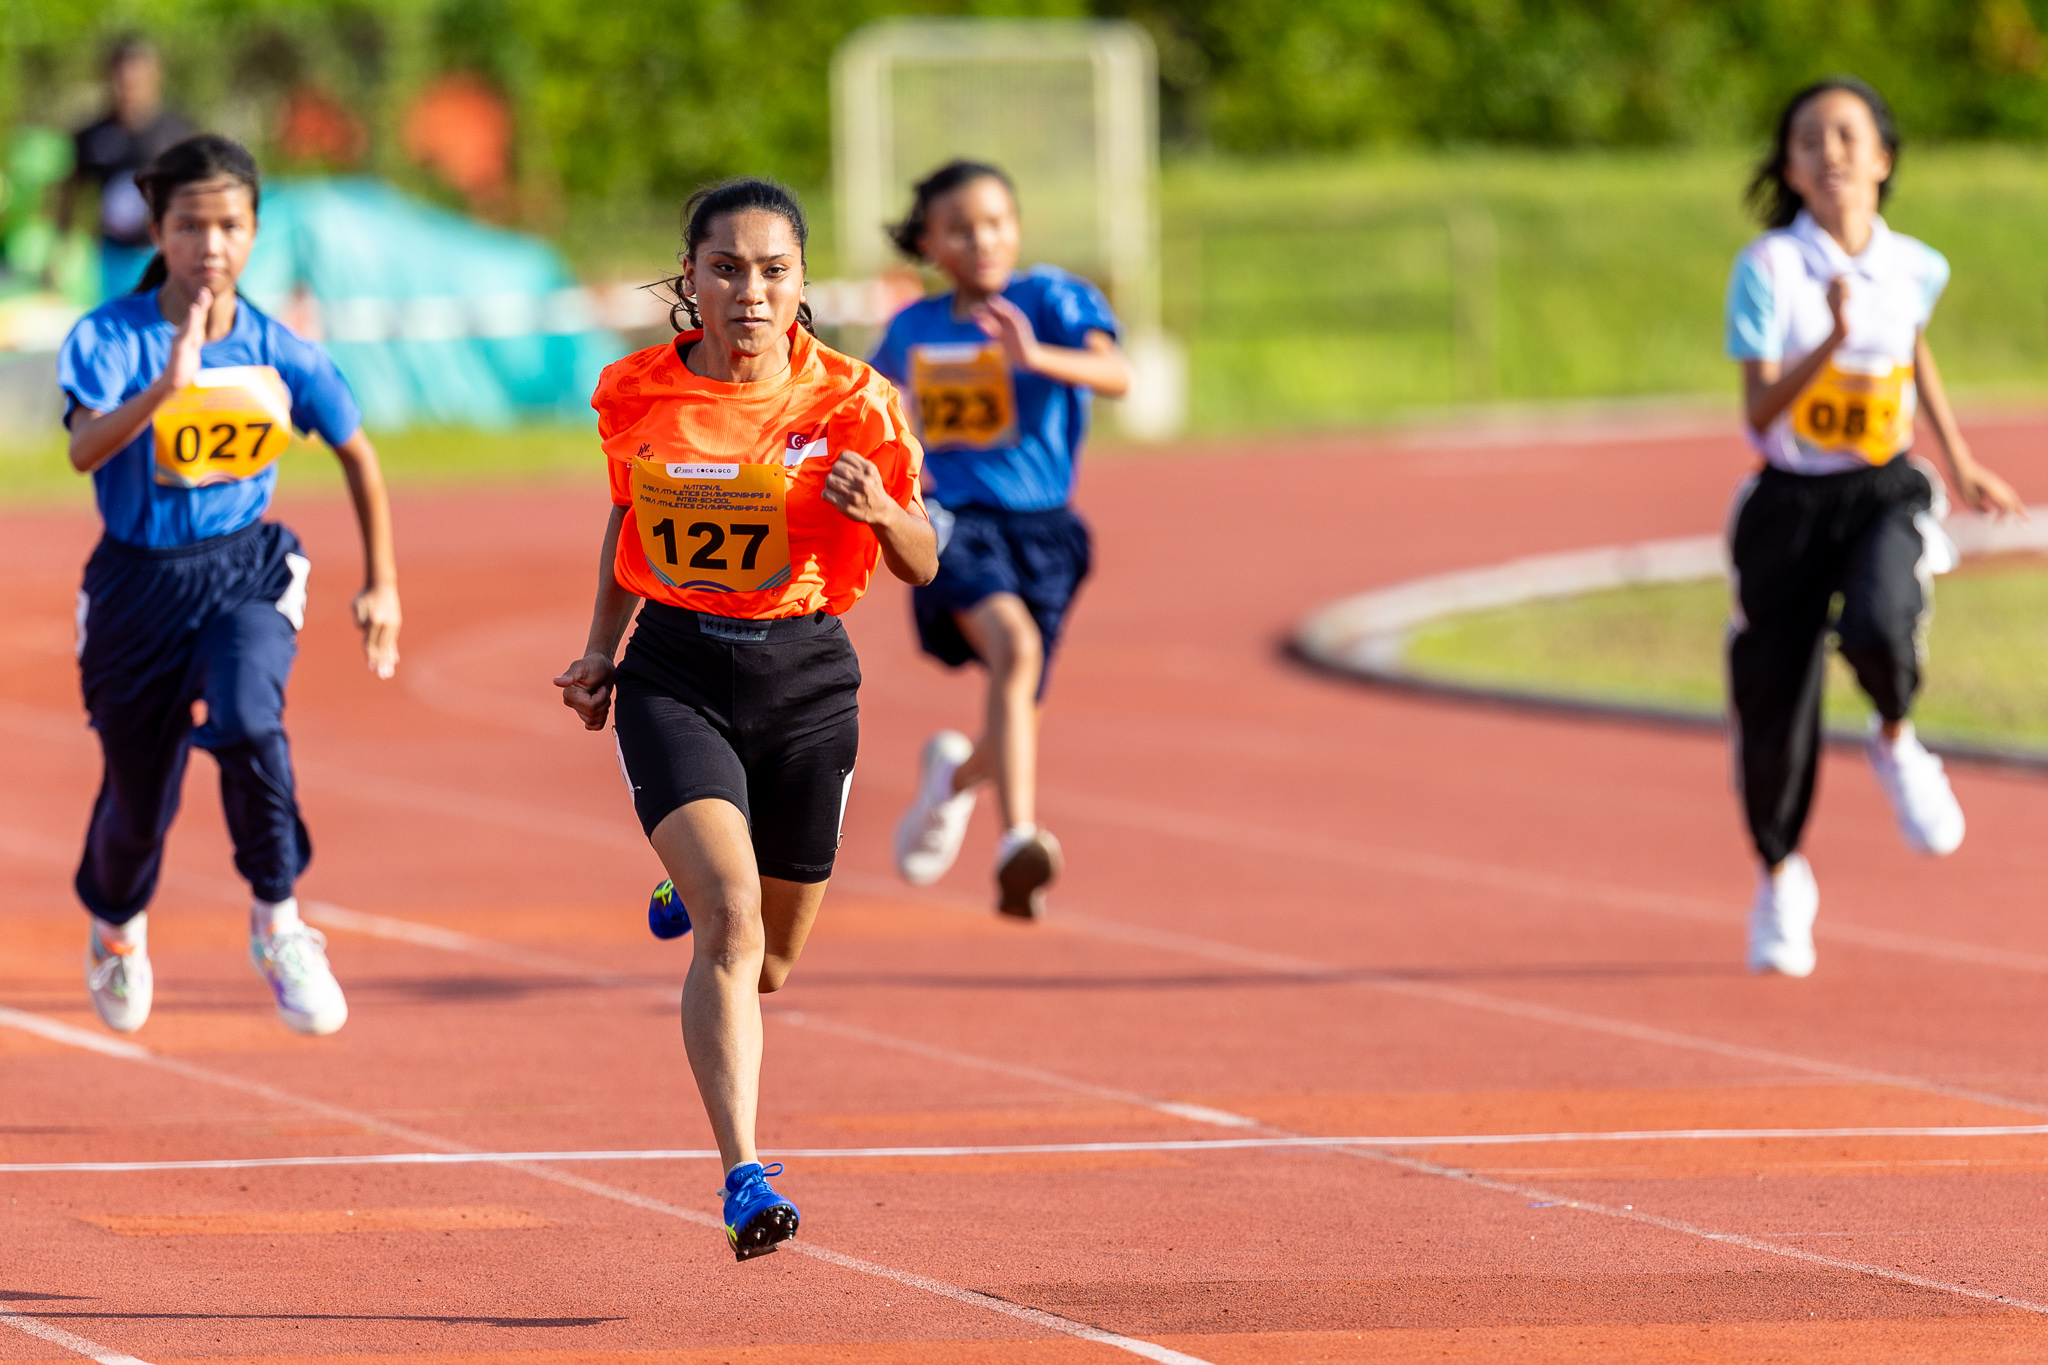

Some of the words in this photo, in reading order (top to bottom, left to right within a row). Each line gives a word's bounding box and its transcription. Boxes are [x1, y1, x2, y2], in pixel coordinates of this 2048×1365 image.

[174, 422, 273, 463] 027
[642, 483, 660, 493] PARA
[660, 488, 700, 497] ATHLETICS
[701, 491, 765, 499] CHAMPIONSHIPS
[640, 494, 656, 504] PARA
[657, 500, 696, 509] ATHLETICS
[696, 503, 759, 512] CHAMPIONSHIPS
[676, 496, 732, 504] INTER-SCHOOL
[652, 518, 770, 570] 127
[705, 619, 762, 636] KIPSTA
